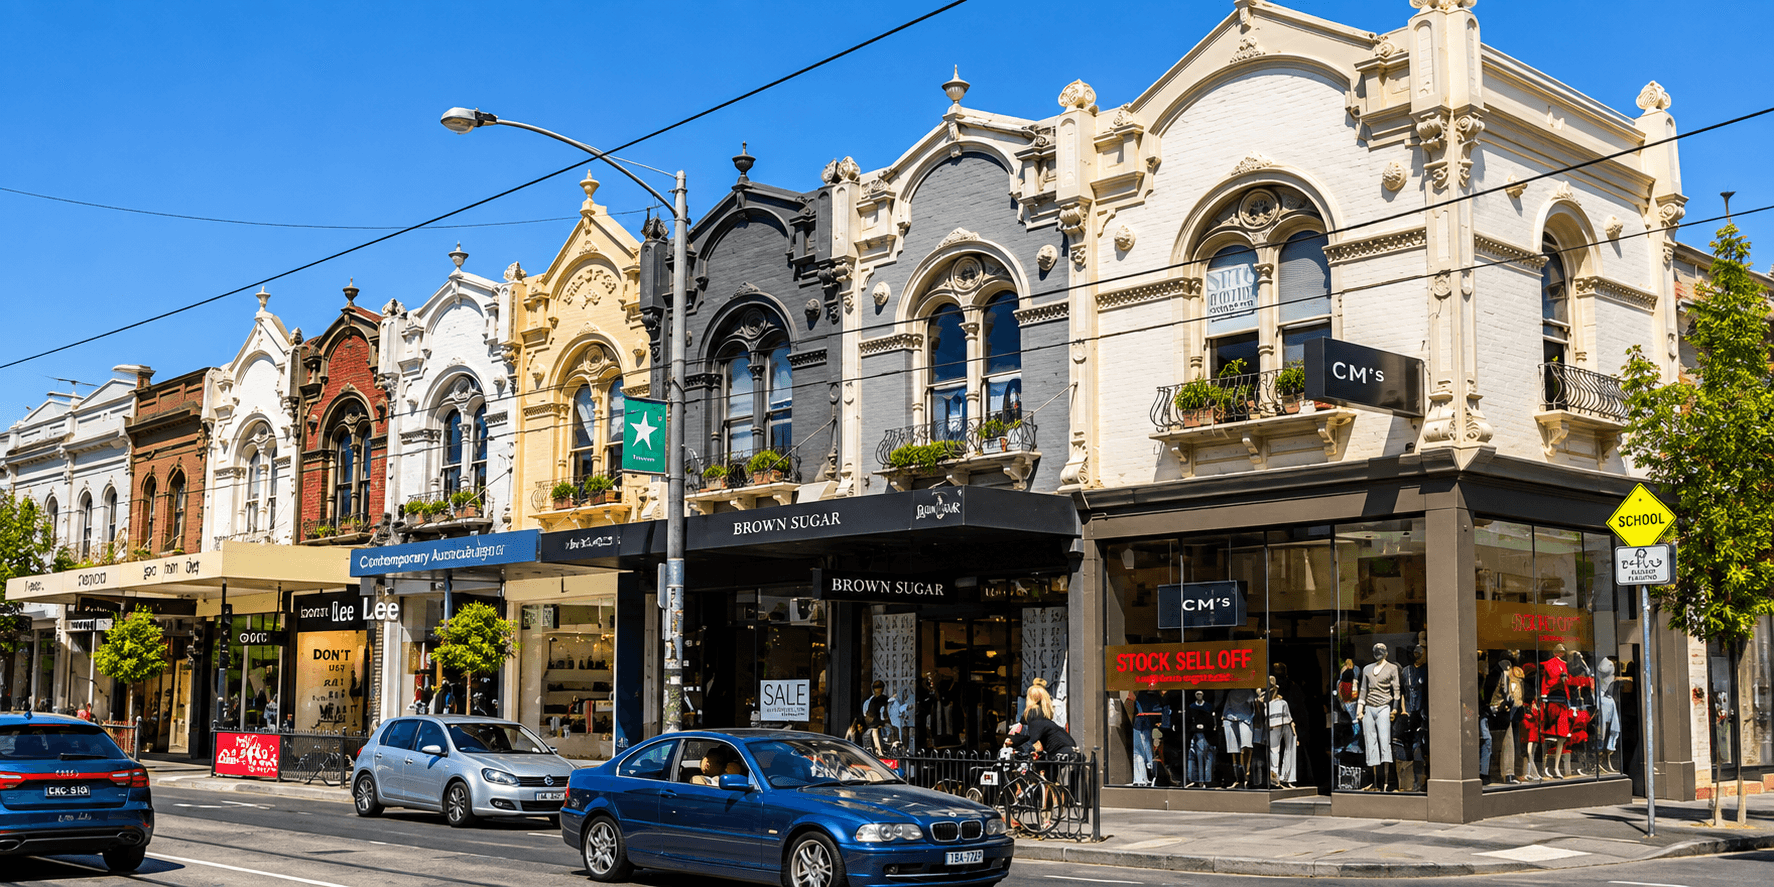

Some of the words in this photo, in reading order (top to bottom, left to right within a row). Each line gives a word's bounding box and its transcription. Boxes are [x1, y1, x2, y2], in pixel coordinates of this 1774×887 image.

[732, 517, 787, 535] BROWN
[790, 511, 841, 529] SUGAR
[1618, 513, 1665, 528] SCHOOL
[831, 578, 890, 594] BROWN
[895, 581, 944, 596] SUGAR
[362, 597, 399, 620] Lee
[1182, 597, 1231, 611] CM's
[313, 649, 351, 661] DON'T
[1116, 652, 1171, 672] STOCK
[1175, 650, 1215, 671] SELL
[1217, 648, 1253, 669] OFF
[763, 684, 806, 706] SALE
